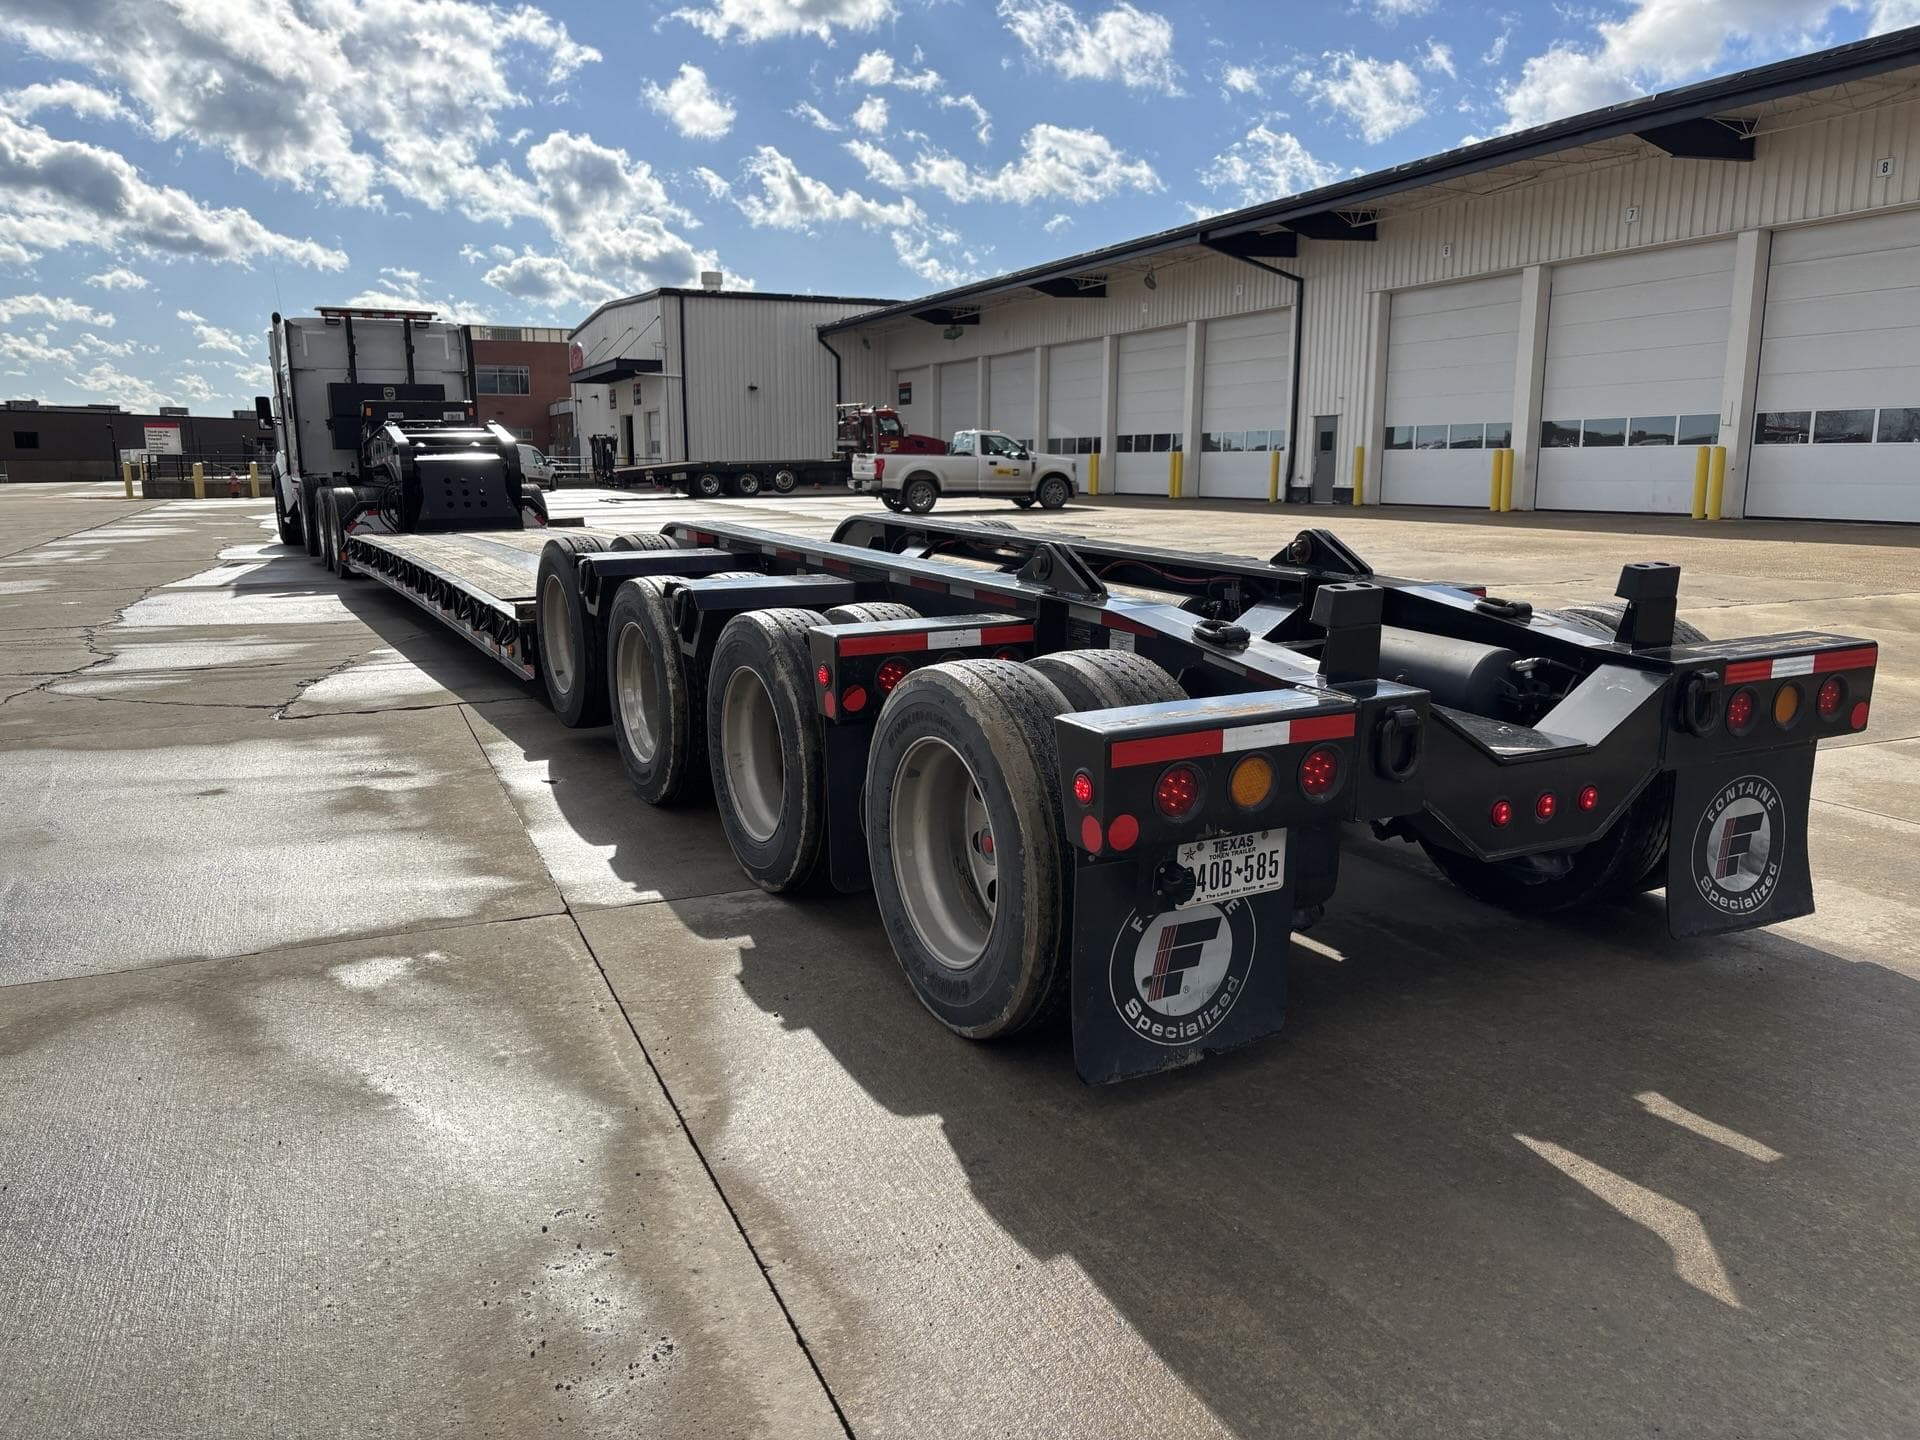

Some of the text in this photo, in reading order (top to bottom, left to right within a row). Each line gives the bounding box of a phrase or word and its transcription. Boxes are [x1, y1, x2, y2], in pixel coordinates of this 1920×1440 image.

[1882, 161, 1889, 174] 8
[1707, 781, 1777, 823] FONTAINE
[1209, 846, 1257, 861] TOKEN TRAILER
[1212, 835, 1254, 854] TEXAS
[1701, 861, 1777, 910] Specialized
[1124, 975, 1240, 1039] Specialized
